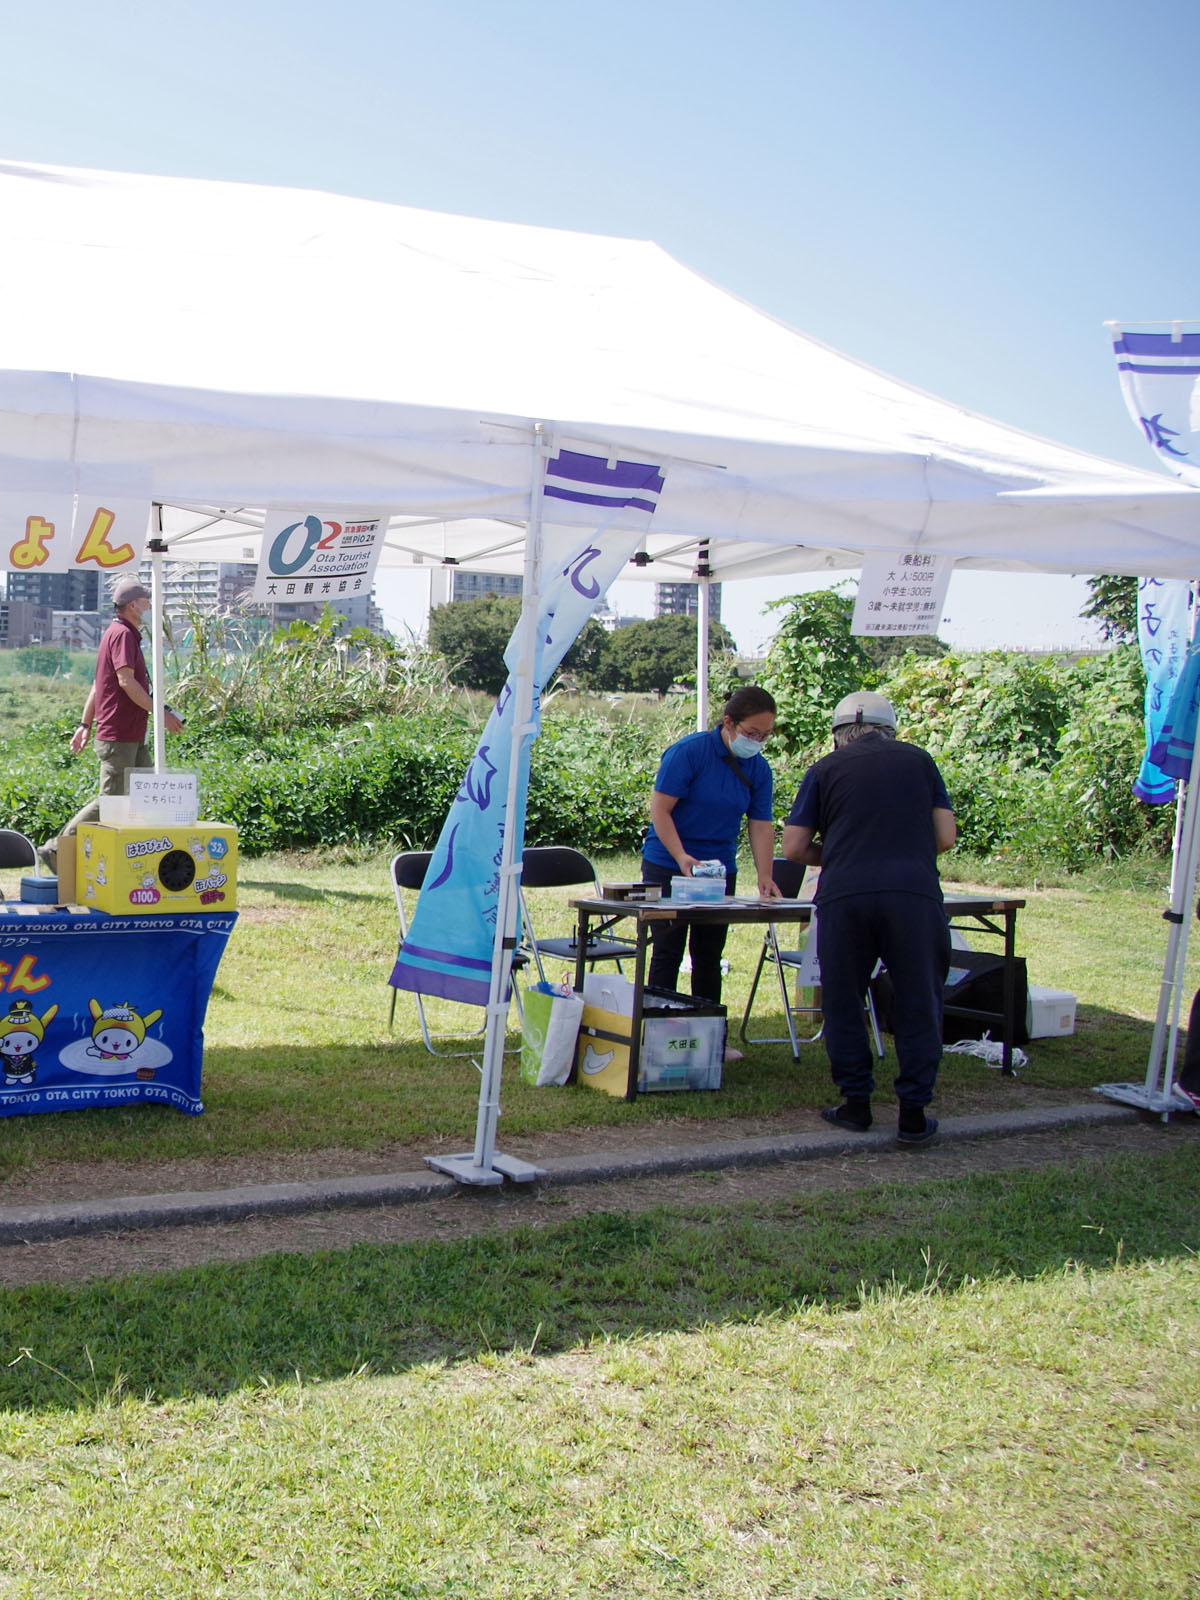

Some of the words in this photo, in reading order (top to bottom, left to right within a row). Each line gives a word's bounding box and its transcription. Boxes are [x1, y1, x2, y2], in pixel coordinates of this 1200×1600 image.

[316, 553, 335, 562] Ota
[338, 551, 371, 562] Tourist
[309, 561, 369, 573] Association
[134, 781, 193, 790] 空のカプセルは
[127, 838, 171, 857] はねぴょん
[25, 923, 68, 932] TOKYO
[73, 922, 97, 931] OTA
[101, 921, 130, 930] CITY
[133, 920, 174, 929] TOKYO
[179, 920, 203, 929] OTA
[206, 920, 233, 930] CITY
[1, 1093, 40, 1105] TOKYO
[46, 1090, 69, 1100] OTA
[72, 1089, 101, 1099] CITY
[104, 1088, 140, 1098] TOKYO
[145, 1088, 168, 1098] OTA
